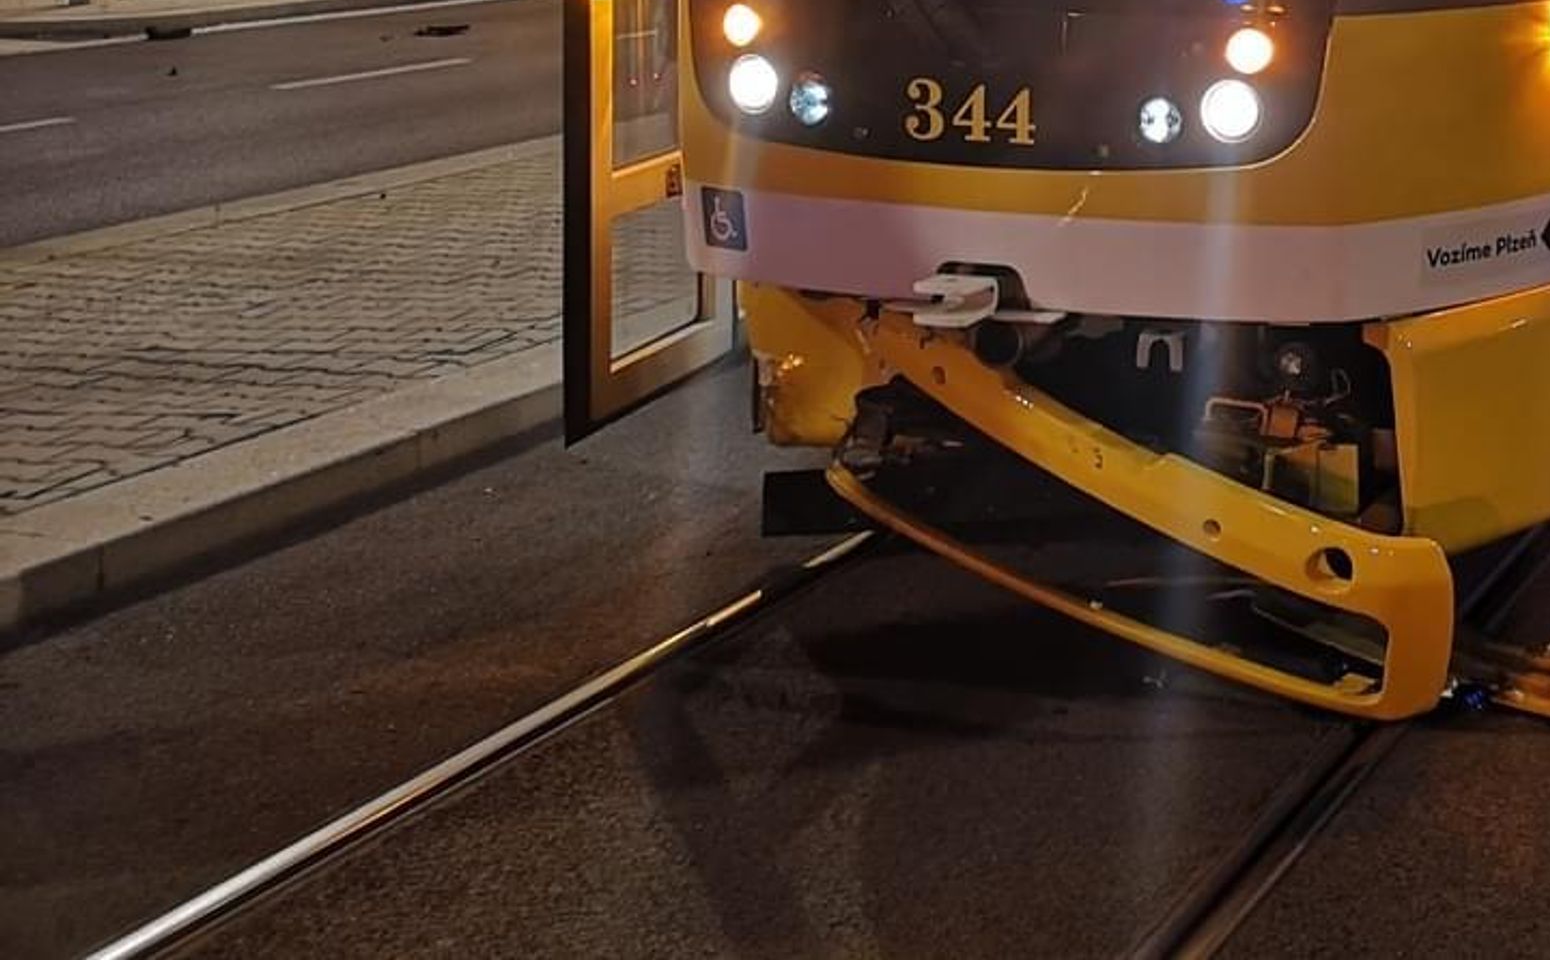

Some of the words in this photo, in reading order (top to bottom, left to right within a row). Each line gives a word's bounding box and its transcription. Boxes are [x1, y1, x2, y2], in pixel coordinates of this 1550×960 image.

[905, 78, 1036, 145] 344
[1426, 242, 1492, 268] Vozíme
[1496, 229, 1537, 257] Plzeň
